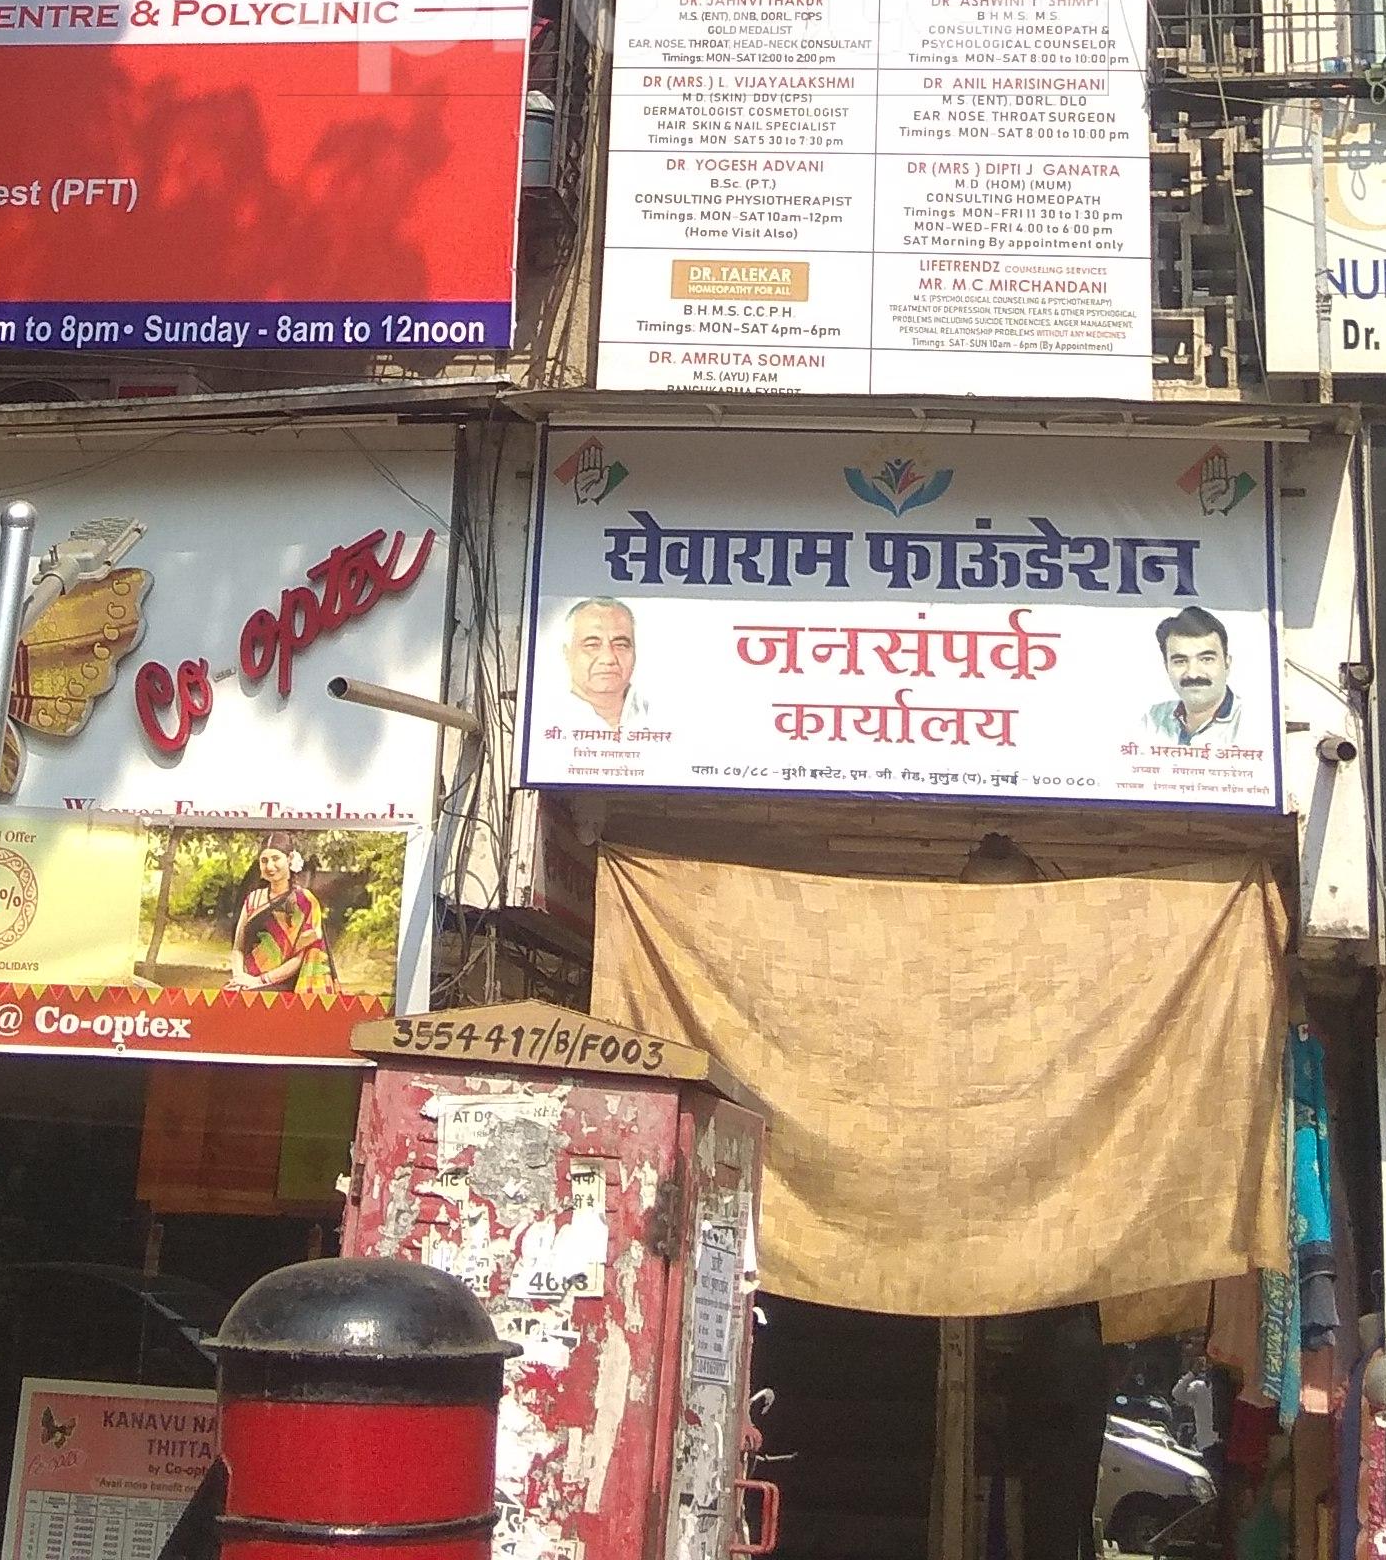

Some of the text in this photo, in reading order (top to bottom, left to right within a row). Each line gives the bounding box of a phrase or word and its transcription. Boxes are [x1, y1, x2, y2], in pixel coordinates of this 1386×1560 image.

[130, 0, 160, 26] &
[734, 77, 854, 88] VIJAYALAKSHMI
[992, 78, 1105, 90] HARISINGHANI
[696, 160, 824, 172] YOGESH ADVANI
[1043, 164, 1120, 176] GANATRA
[50, 178, 138, 212] (PFT)
[635, 194, 852, 206] CONSULTING PHYSIOTHERAPIST
[920, 260, 1000, 272] LIFETRENDZ
[721, 267, 791, 283] TALEKAR
[990, 280, 1107, 293] MIRCHANDANI
[26, 316, 51, 342] to
[144, 316, 250, 348] Sunday
[277, 316, 334, 342] 8am
[344, 317, 370, 342] to
[381, 316, 484, 342] 12noon
[1343, 320, 1380, 350] Dr.
[681, 353, 825, 367] AMRUTA SOMANI
[604, 511, 1201, 596] सेवाराम फाऊंडेशन
[733, 608, 1061, 680] जनसंपर्क
[772, 689, 1018, 746] कार्यालय
[5, 831, 37, 845] Offer
[35, 1006, 192, 1042] Co-optex
[103, 1411, 185, 1431] KANAVU
